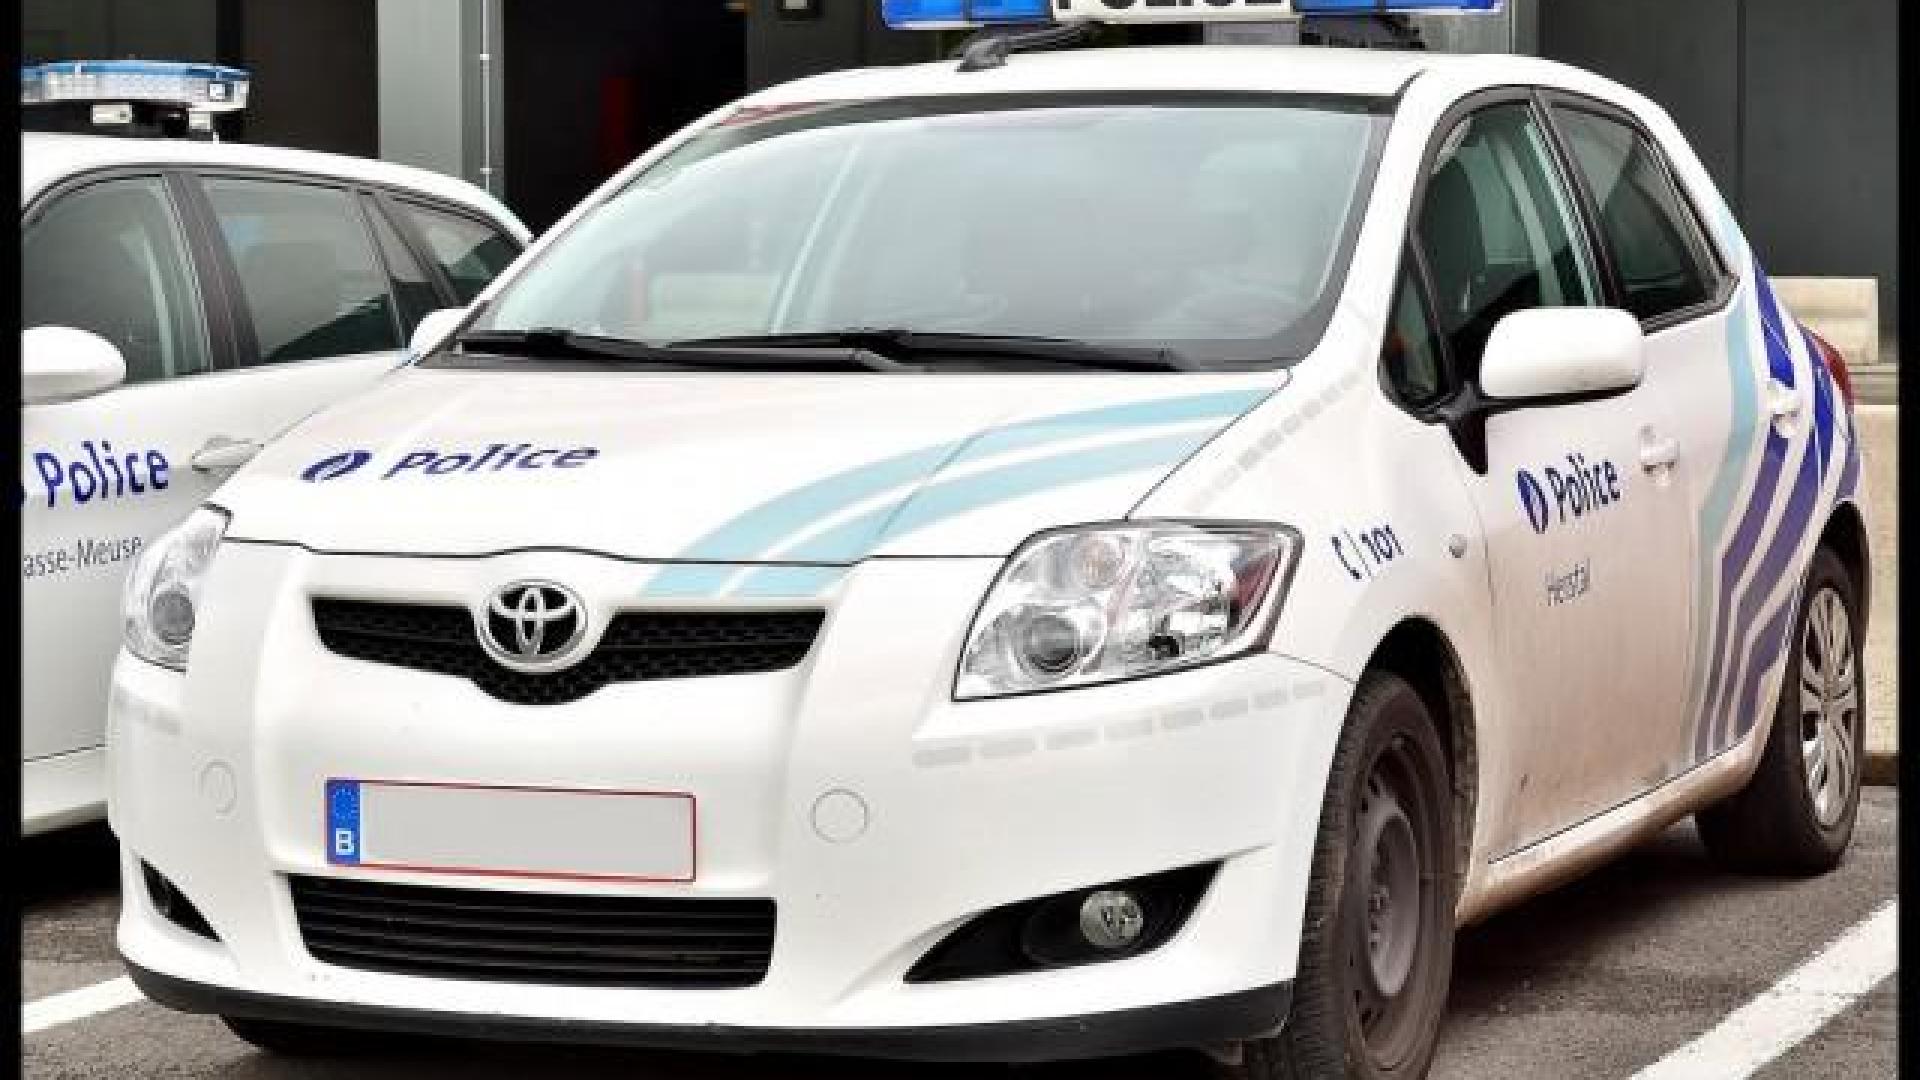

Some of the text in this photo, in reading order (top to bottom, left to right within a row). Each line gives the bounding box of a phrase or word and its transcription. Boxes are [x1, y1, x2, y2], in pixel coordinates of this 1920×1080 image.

[34, 441, 168, 507] Police
[380, 443, 600, 481] Police
[1545, 453, 1620, 523] Police
[336, 828, 354, 855] B
